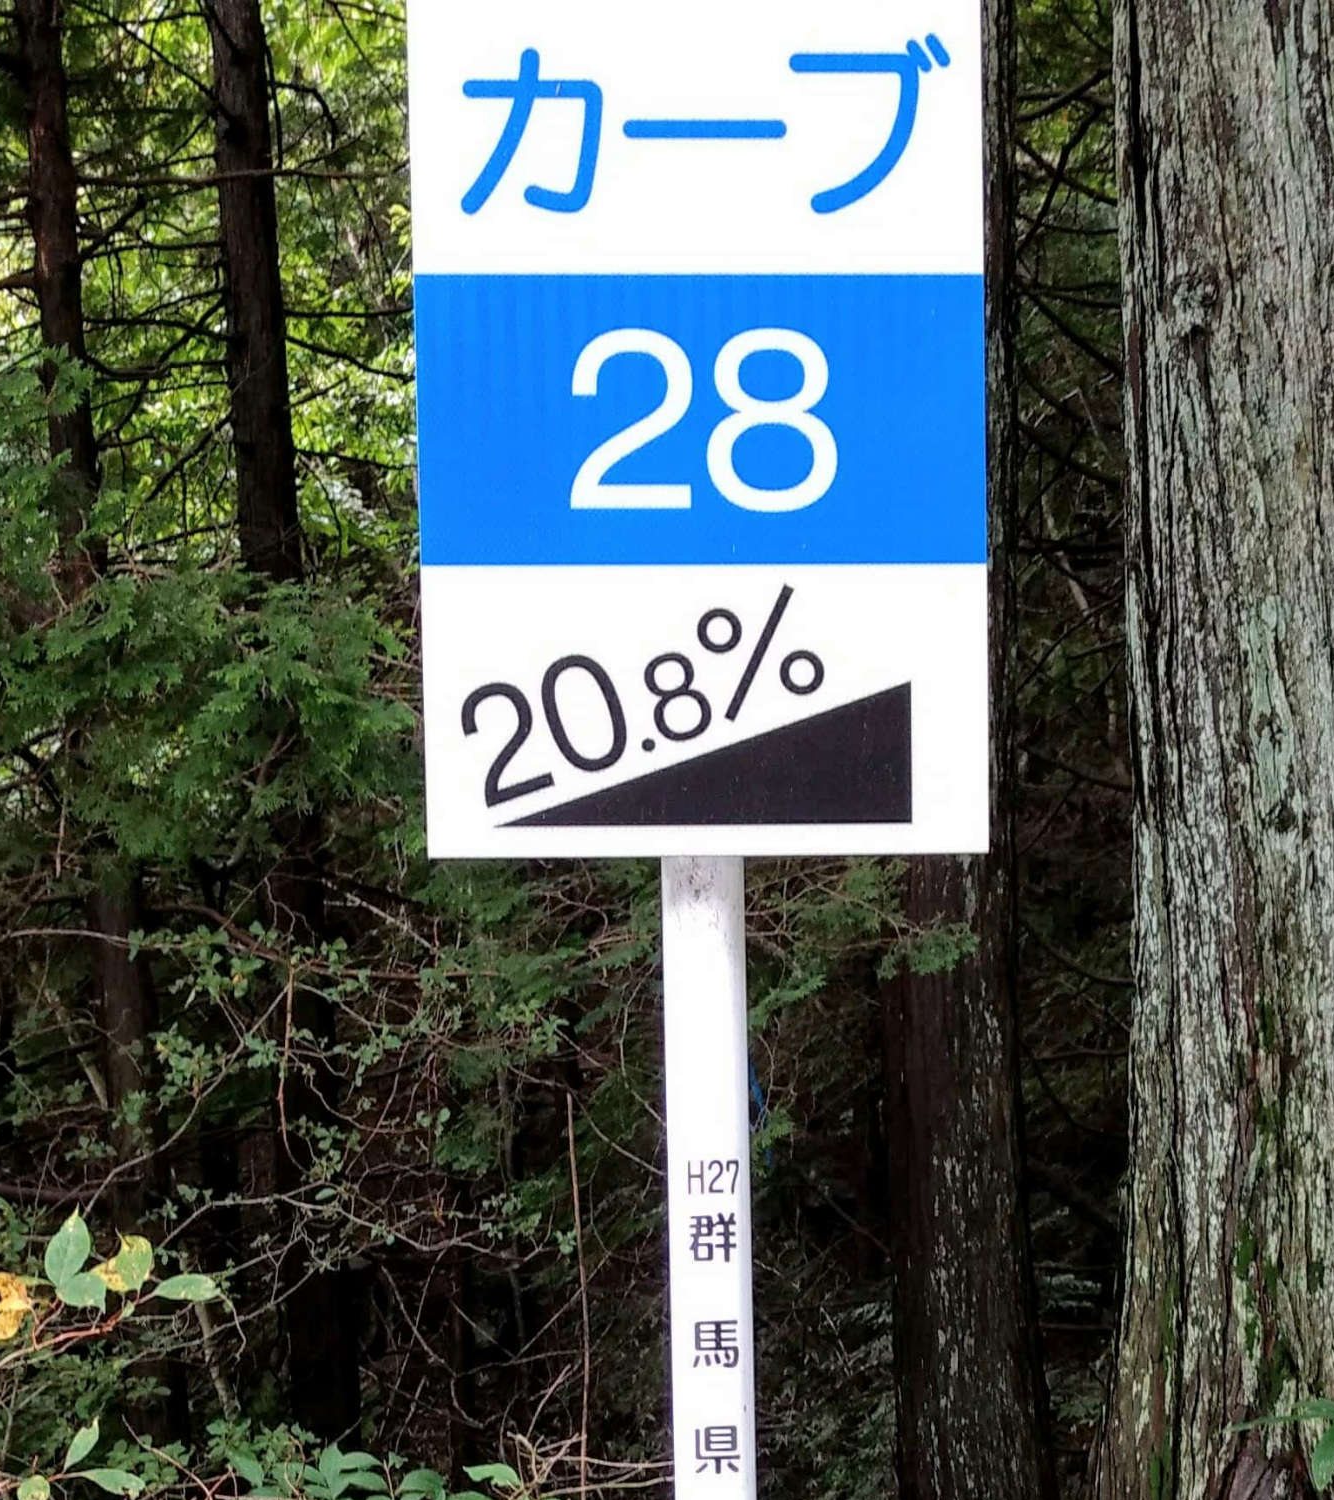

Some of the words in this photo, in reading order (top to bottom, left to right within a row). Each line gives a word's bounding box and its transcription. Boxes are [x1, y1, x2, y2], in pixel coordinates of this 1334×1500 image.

[461, 32, 952, 216] カーブ
[569, 326, 839, 513] 28
[460, 583, 825, 809] 20.8%
[687, 1160, 739, 1195] H27
[689, 1212, 740, 1474] 群馬県
